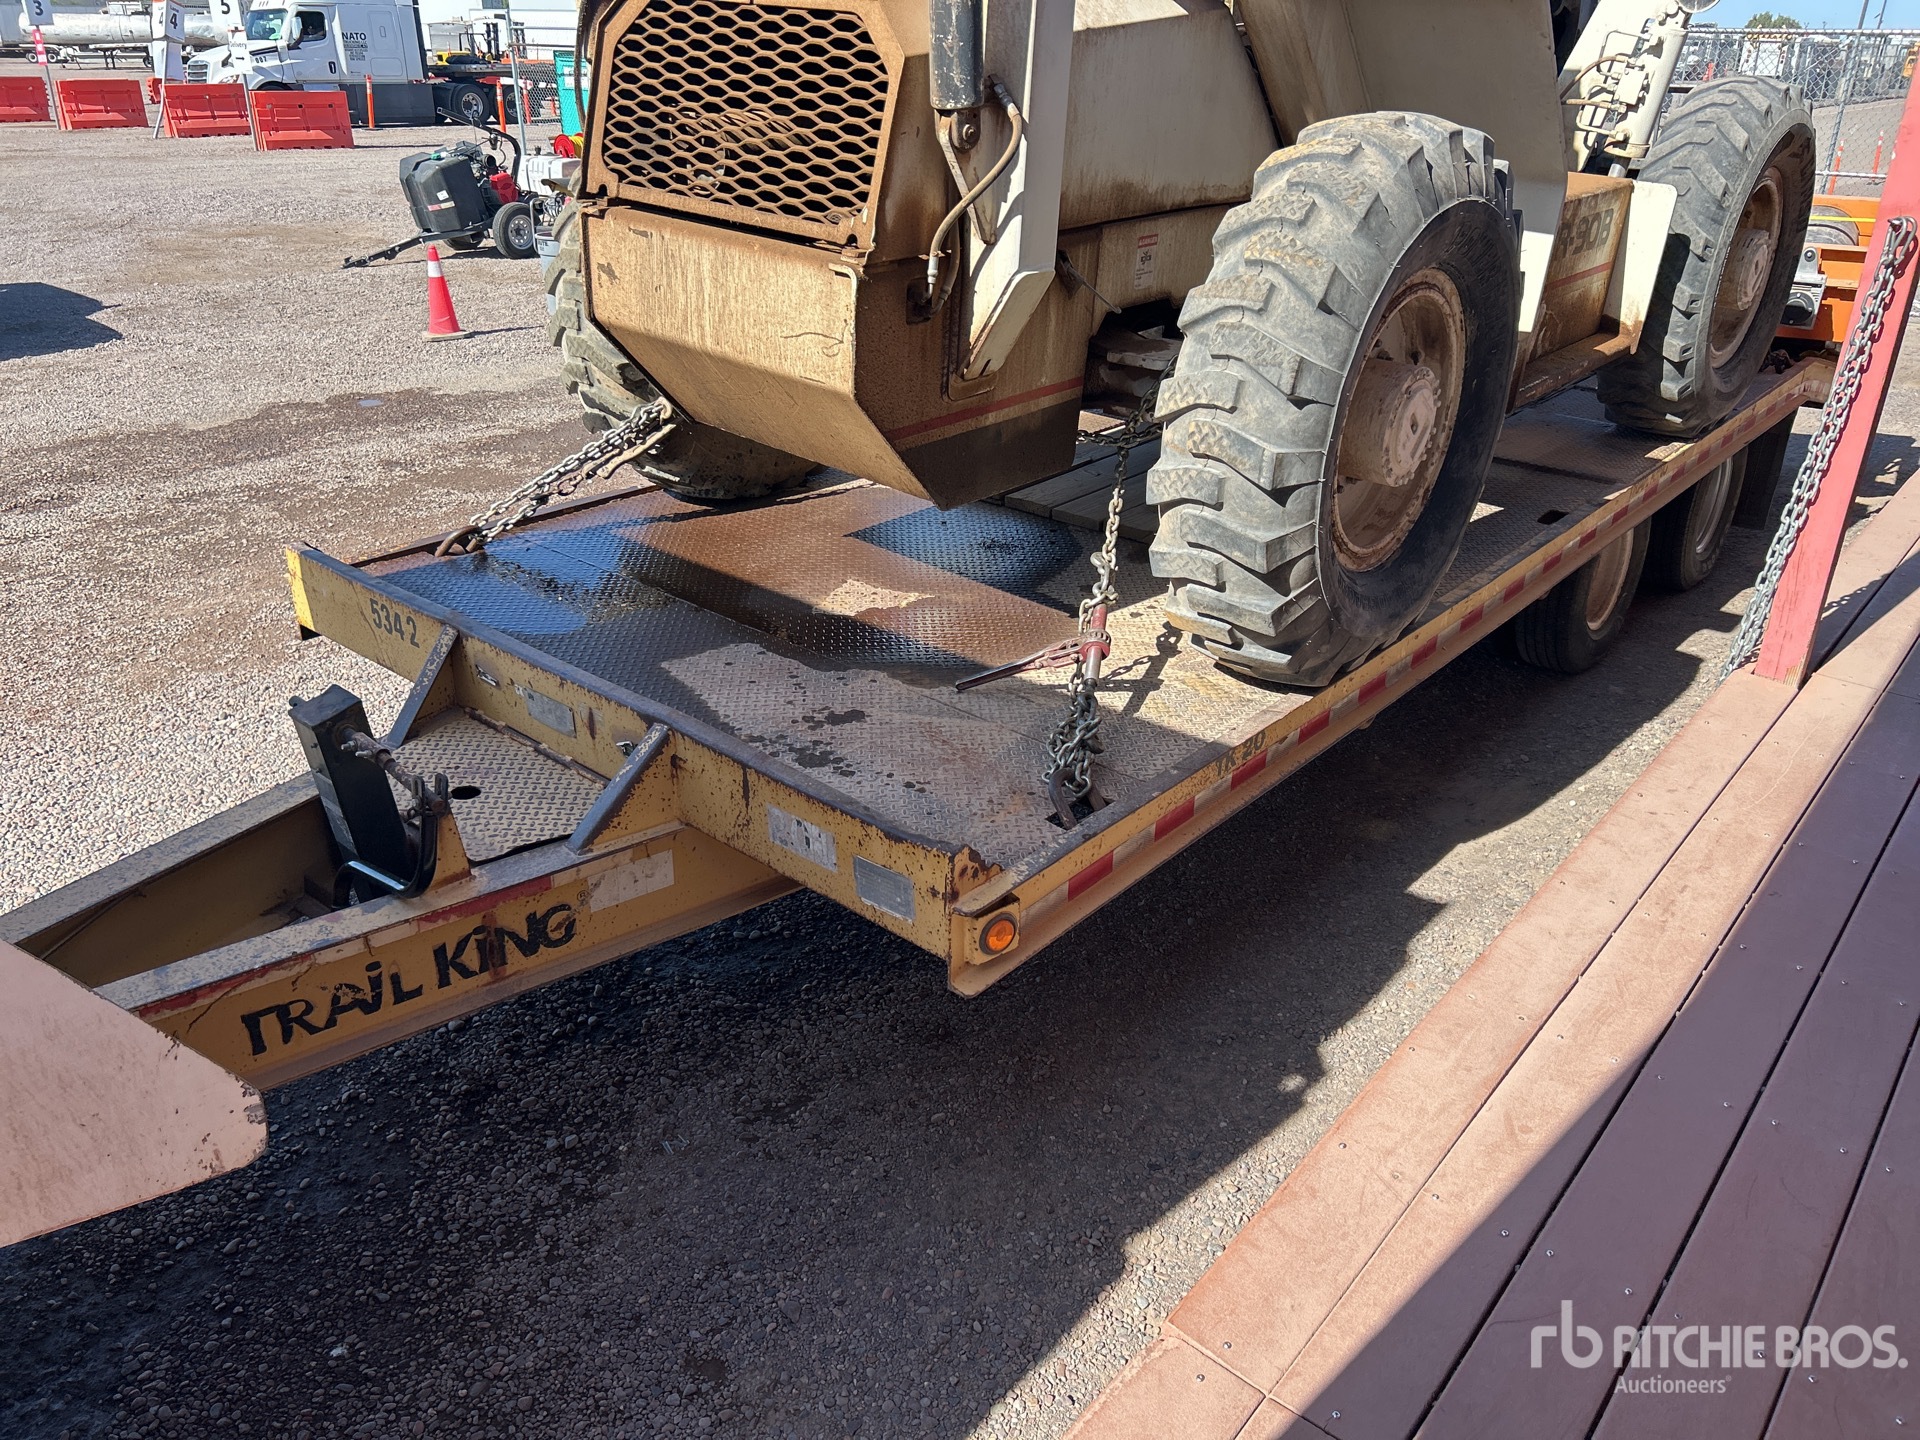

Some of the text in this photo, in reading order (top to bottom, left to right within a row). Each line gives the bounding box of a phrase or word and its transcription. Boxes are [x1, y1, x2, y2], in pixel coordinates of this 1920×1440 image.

[35, 0, 43, 15] 3
[221, 0, 230, 14] 5
[170, 13, 177, 29] 4
[342, 32, 367, 40] NATO
[370, 598, 420, 648] 5342
[1242, 730, 1266, 760] 20
[240, 903, 577, 1057] TRAIL KING
